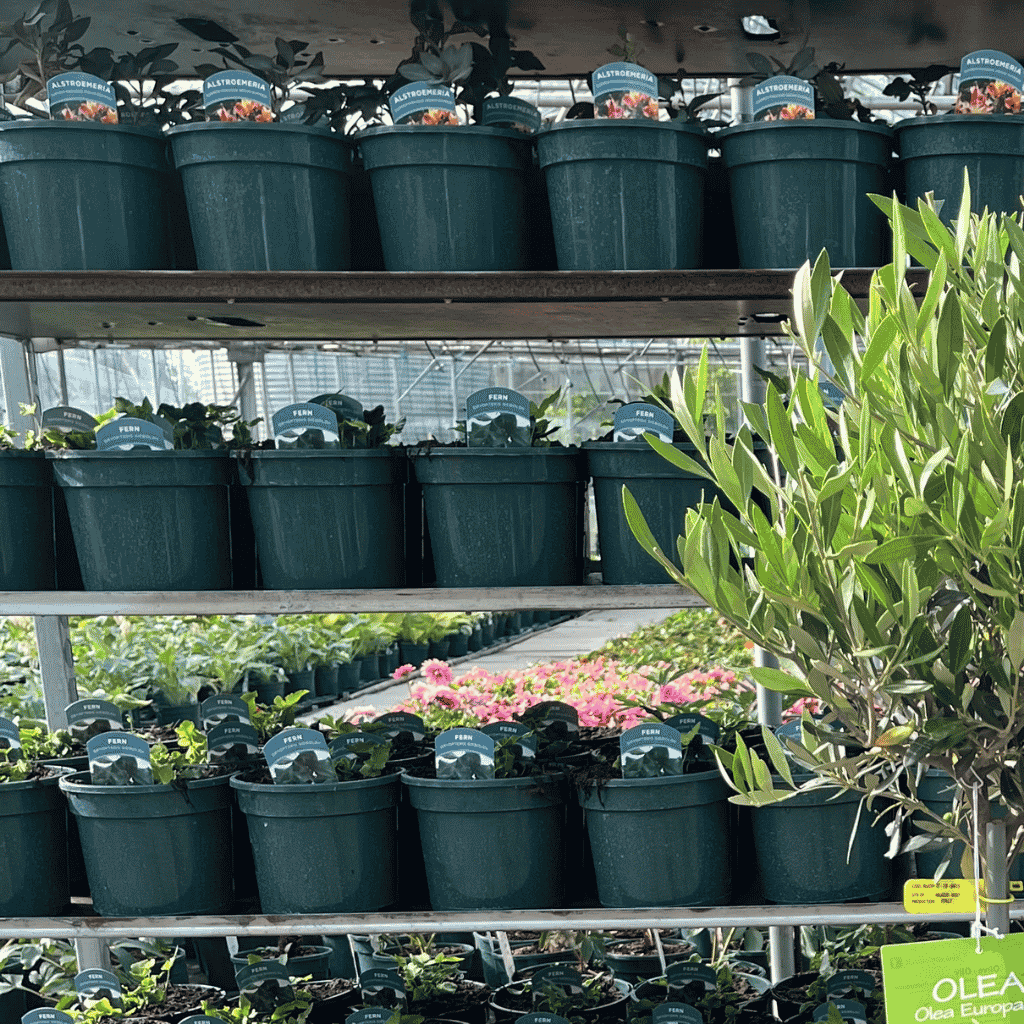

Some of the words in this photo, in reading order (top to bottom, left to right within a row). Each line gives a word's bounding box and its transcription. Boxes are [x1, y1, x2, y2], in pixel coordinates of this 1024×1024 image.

[967, 58, 1022, 75] ALSTROEMERIA
[597, 70, 654, 83] ALSTROEMERIA
[51, 80, 111, 94] ALSTROEMERIA
[207, 79, 266, 92] ALSTROEMERIA
[756, 84, 811, 95] ALSTROEMERIA
[394, 88, 450, 103] ALSTROEMERIA
[63, 411, 82, 420] FERN
[293, 409, 313, 417] FERN
[284, 734, 303, 743] FERN
[914, 1005, 955, 1023] Olea
